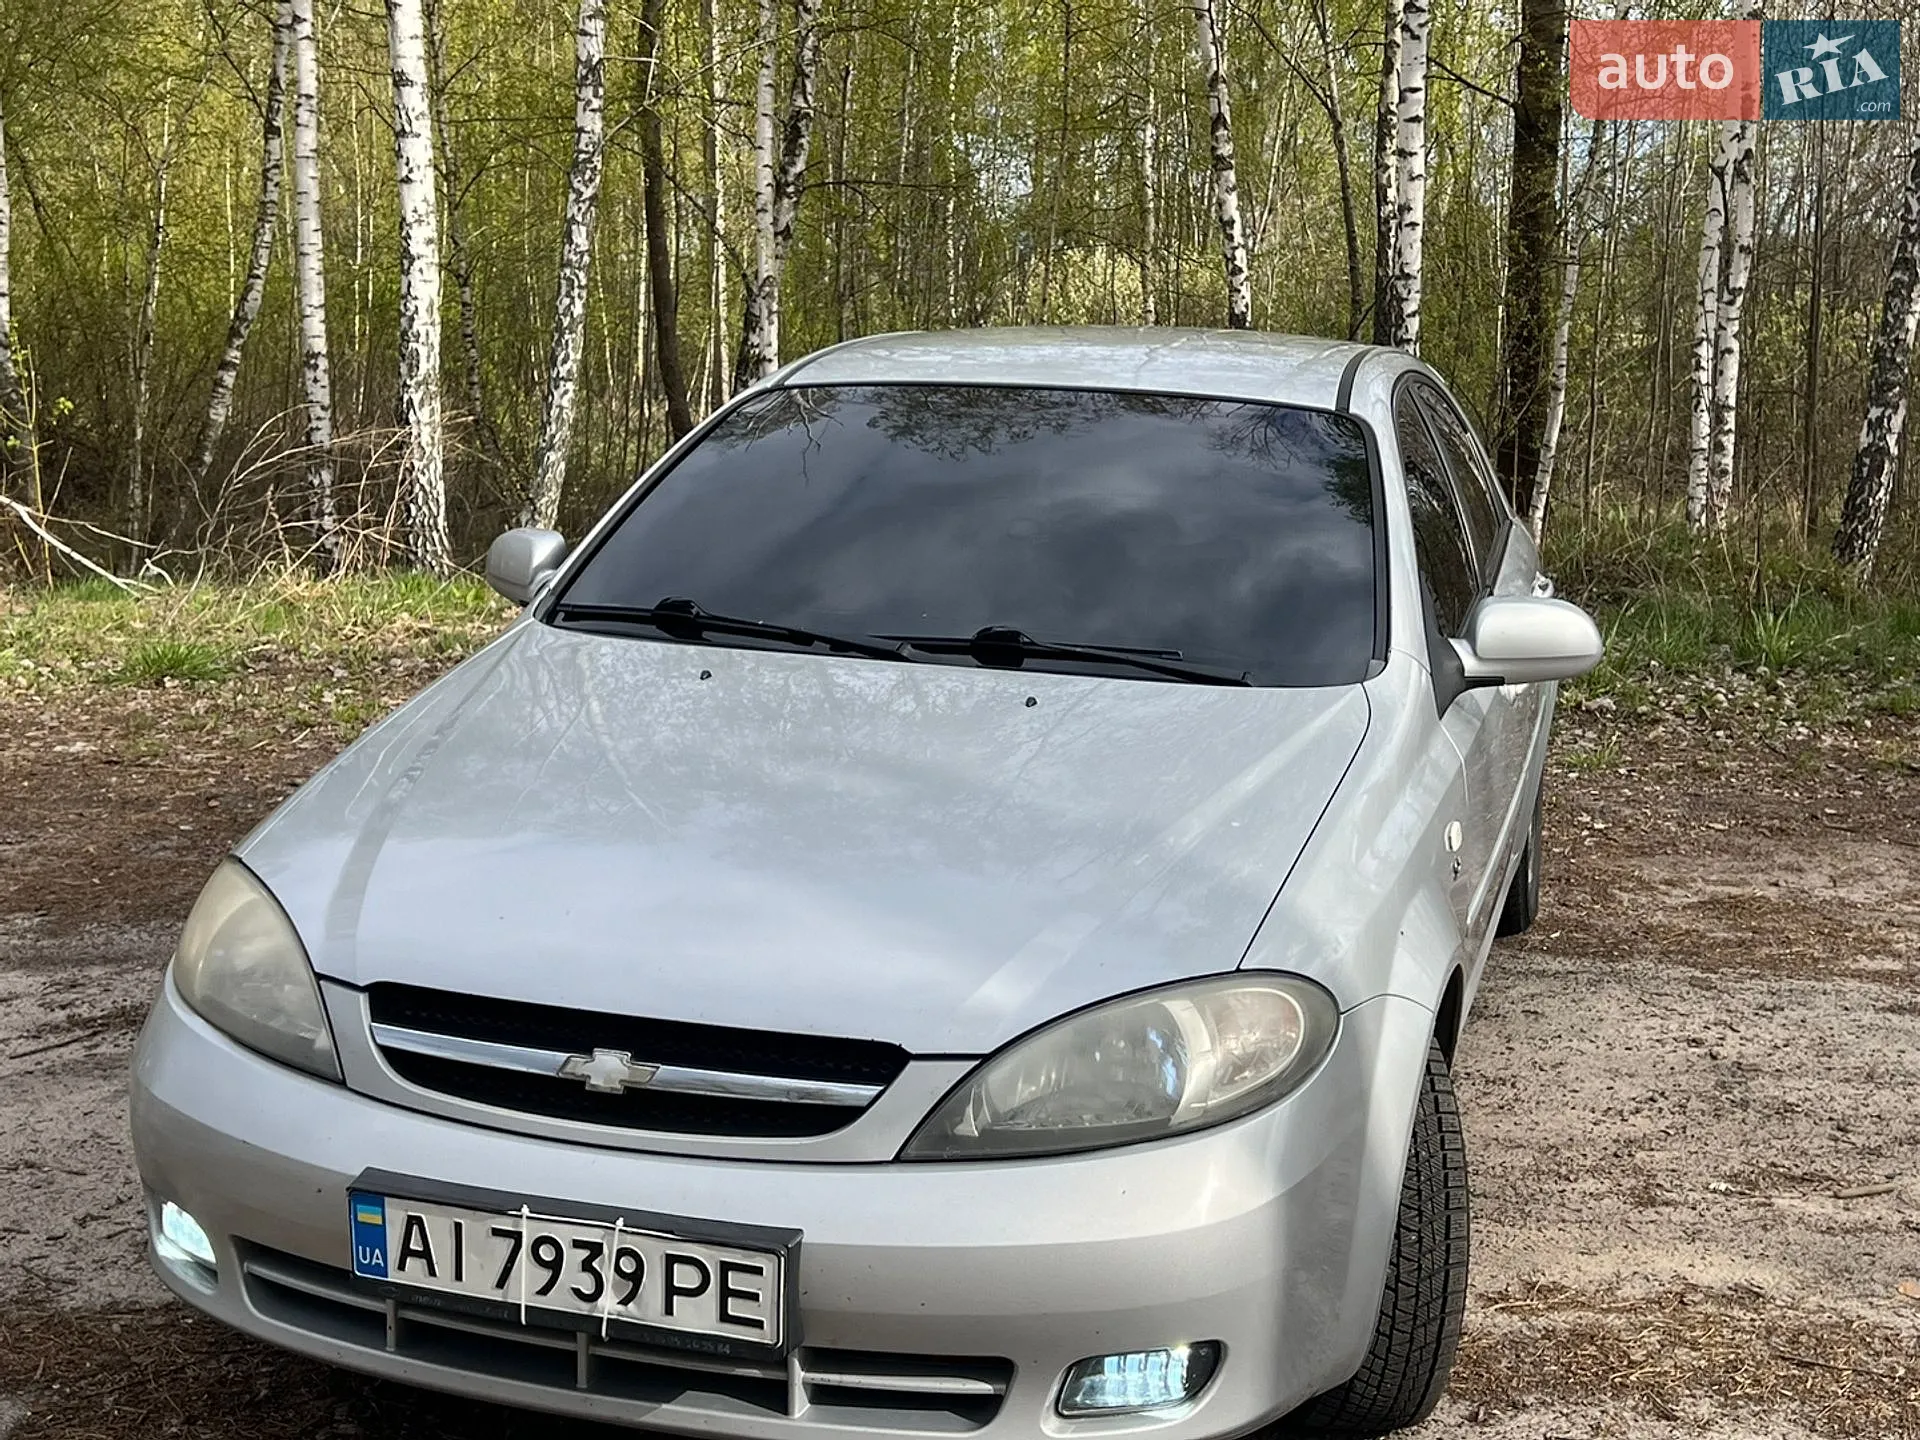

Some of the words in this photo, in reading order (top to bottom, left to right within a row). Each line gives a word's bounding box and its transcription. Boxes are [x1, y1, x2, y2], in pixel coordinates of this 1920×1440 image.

[359, 1246, 384, 1268] UA
[397, 1214, 465, 1282] AI
[491, 1227, 646, 1307] 7939
[664, 1253, 766, 1330] PE
